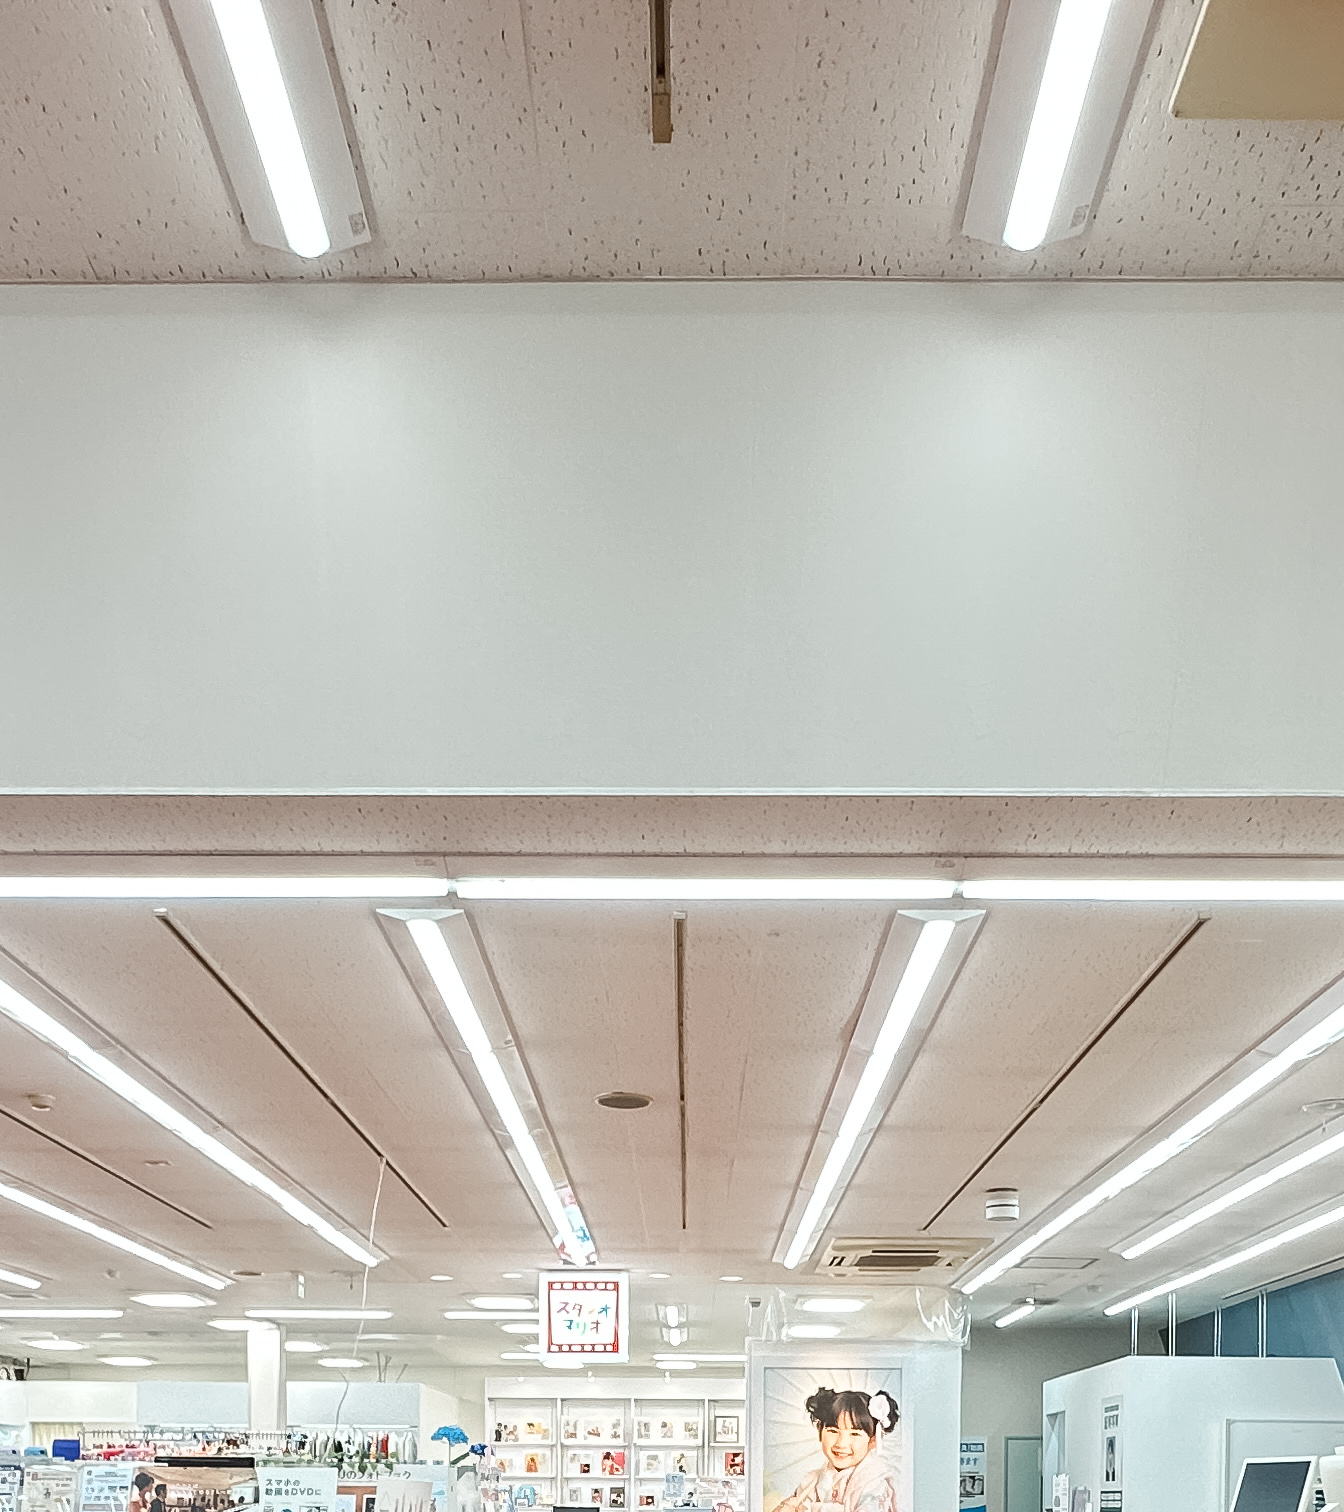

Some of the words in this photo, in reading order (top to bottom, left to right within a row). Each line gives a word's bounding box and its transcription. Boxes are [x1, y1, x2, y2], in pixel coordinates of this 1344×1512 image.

[557, 1302, 611, 1318] スタオ
[563, 1320, 601, 1336] マリオ
